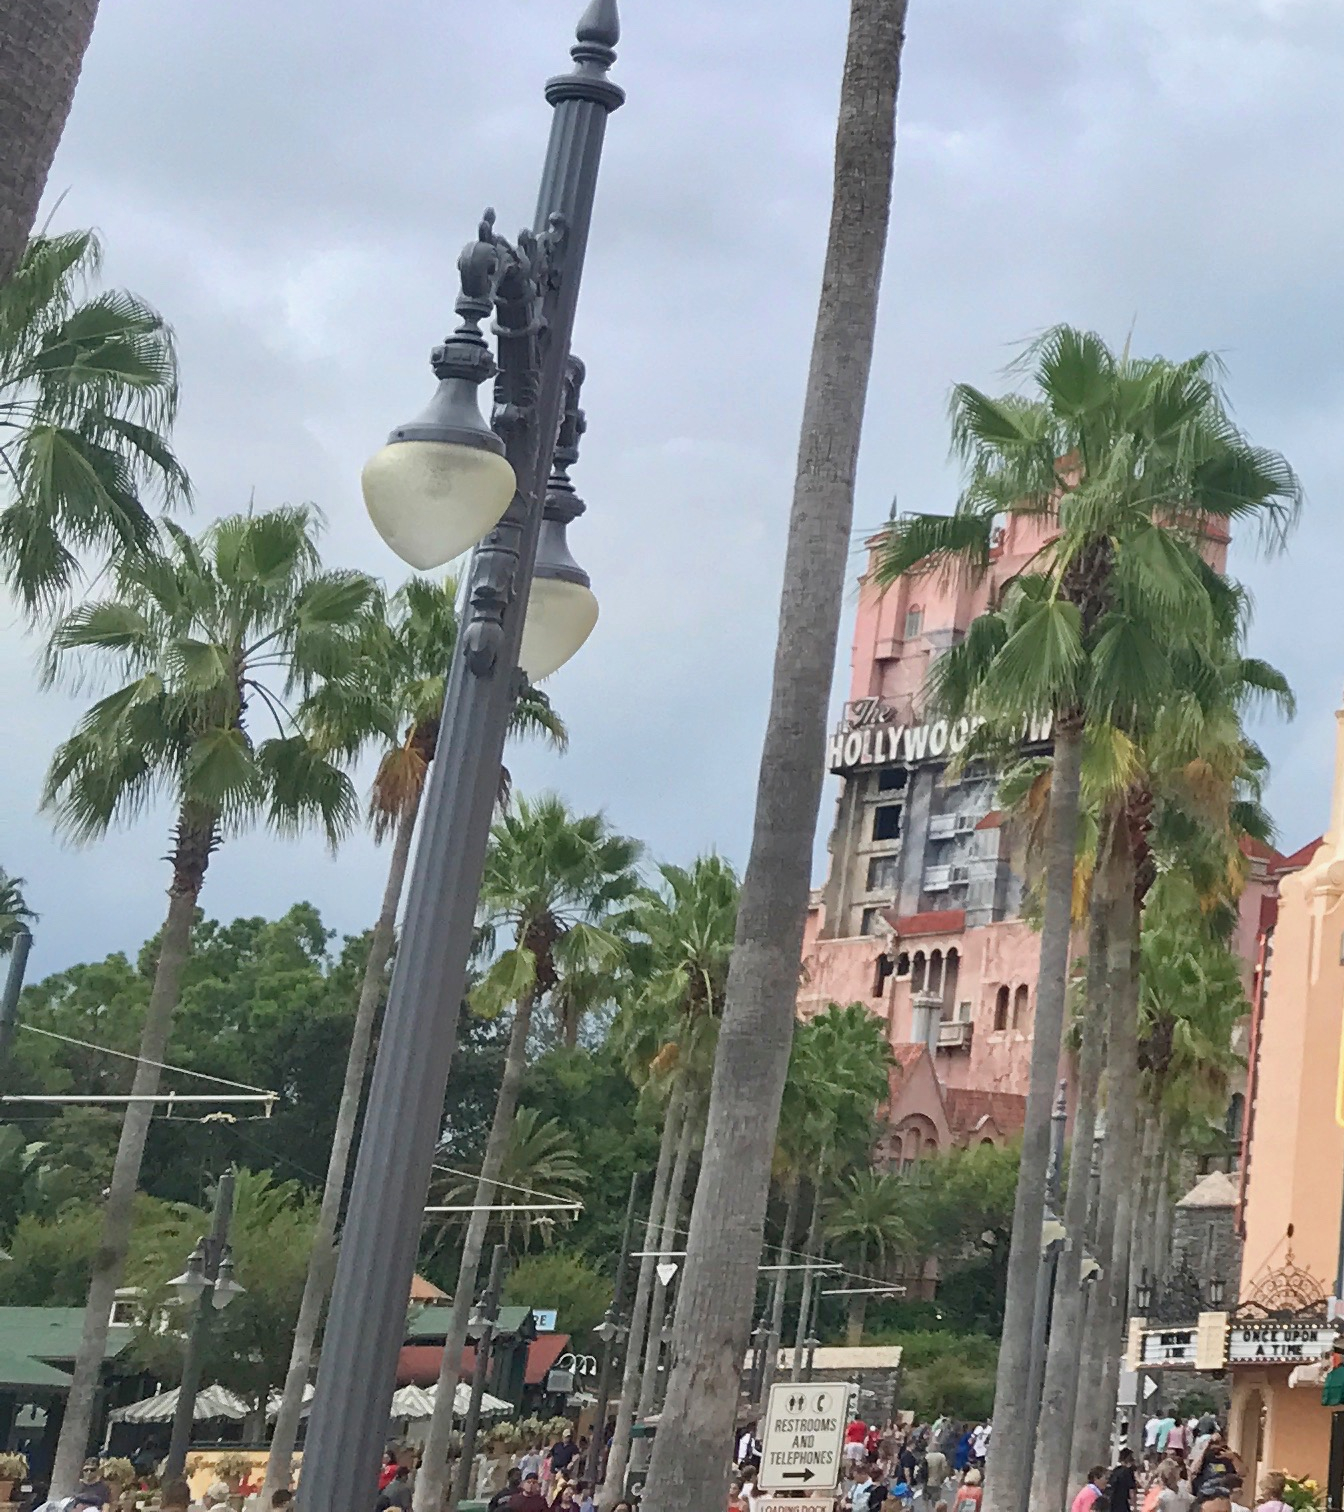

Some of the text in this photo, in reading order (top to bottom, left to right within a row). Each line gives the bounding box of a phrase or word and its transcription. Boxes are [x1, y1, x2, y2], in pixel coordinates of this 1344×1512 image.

[850, 696, 898, 729] The
[1243, 1330, 1318, 1343] ONCE UPON
[1256, 1345, 1303, 1356] A TIME
[774, 1418, 837, 1432] RESTROOMS
[792, 1435, 815, 1449] AND
[770, 1451, 833, 1466] TELEPHONES
